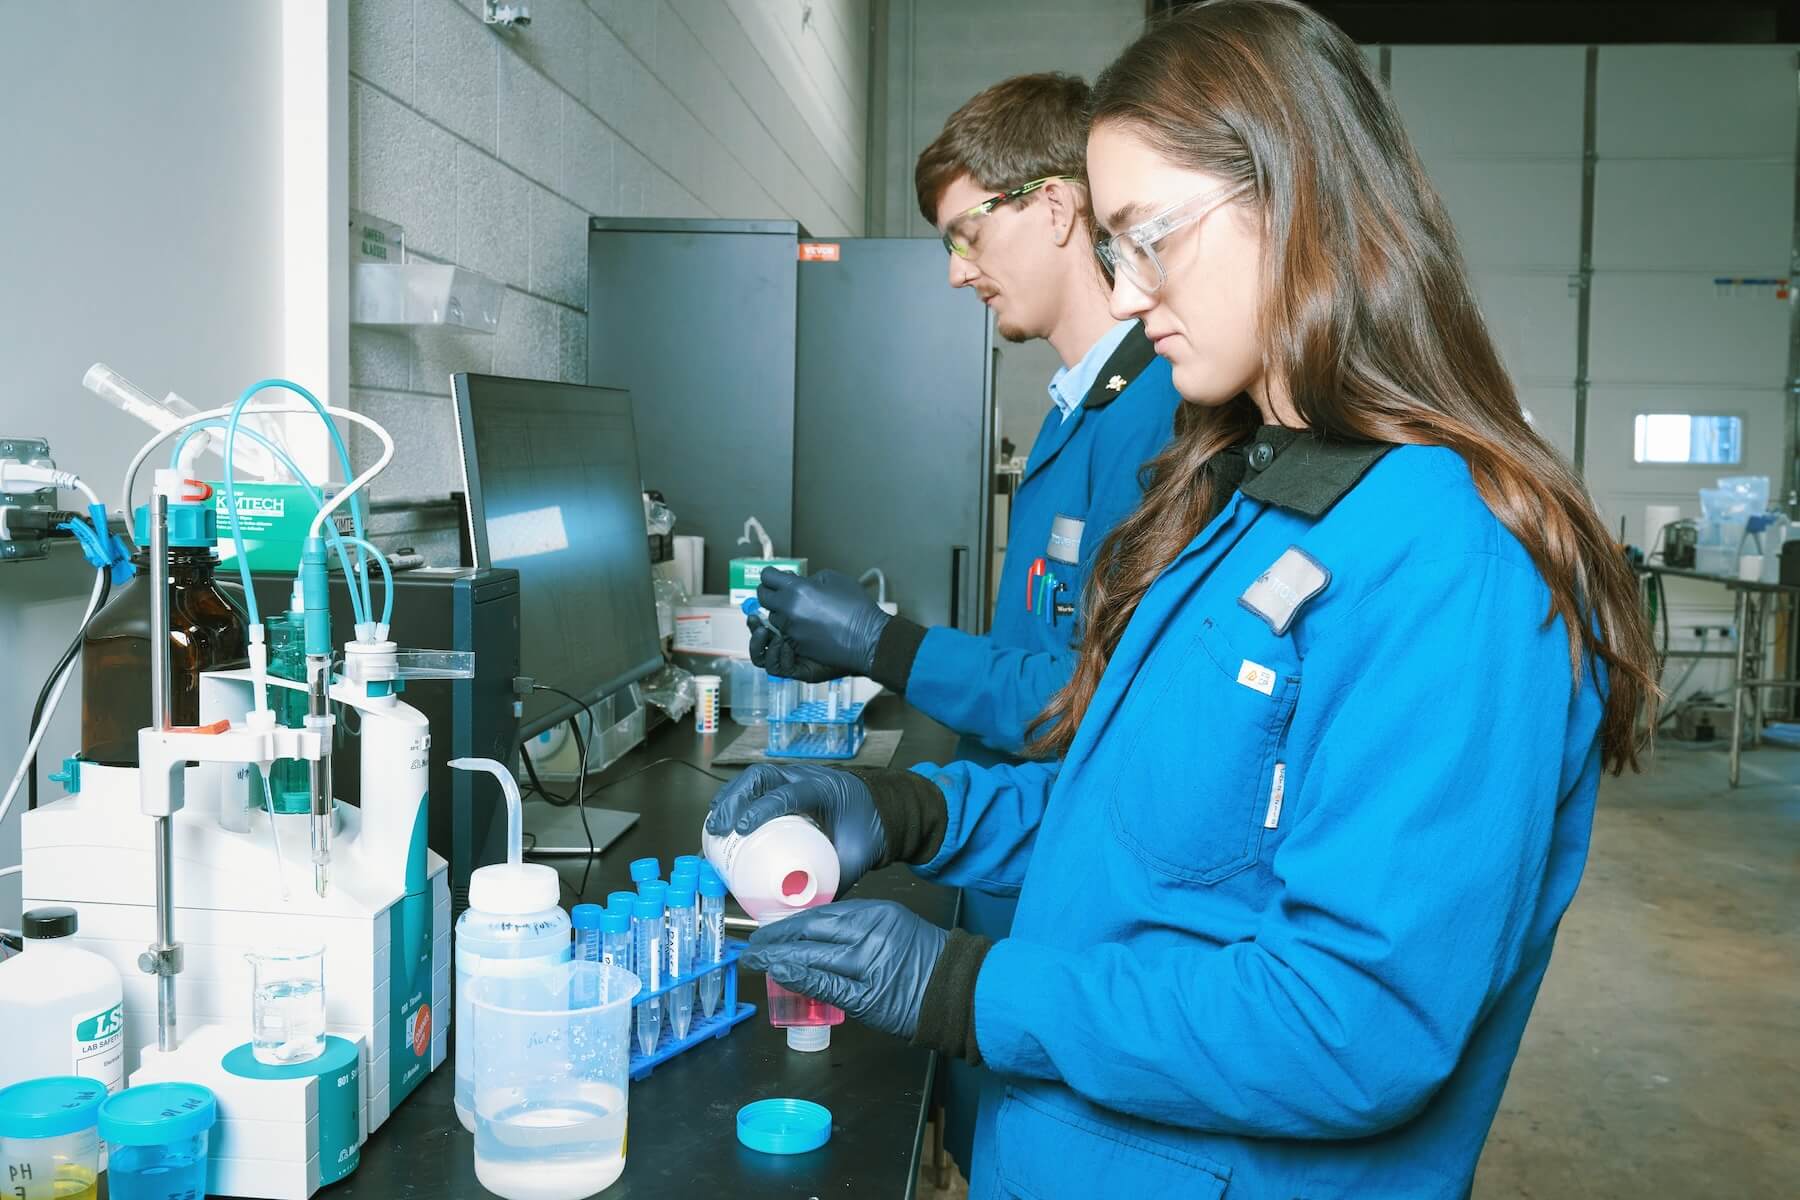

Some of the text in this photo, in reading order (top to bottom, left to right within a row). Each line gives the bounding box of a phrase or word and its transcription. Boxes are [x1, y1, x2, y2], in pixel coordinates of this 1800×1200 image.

[216, 497, 284, 511] KMTECH
[82, 1043, 98, 1054] LAB
[8, 1162, 33, 1183] PH
